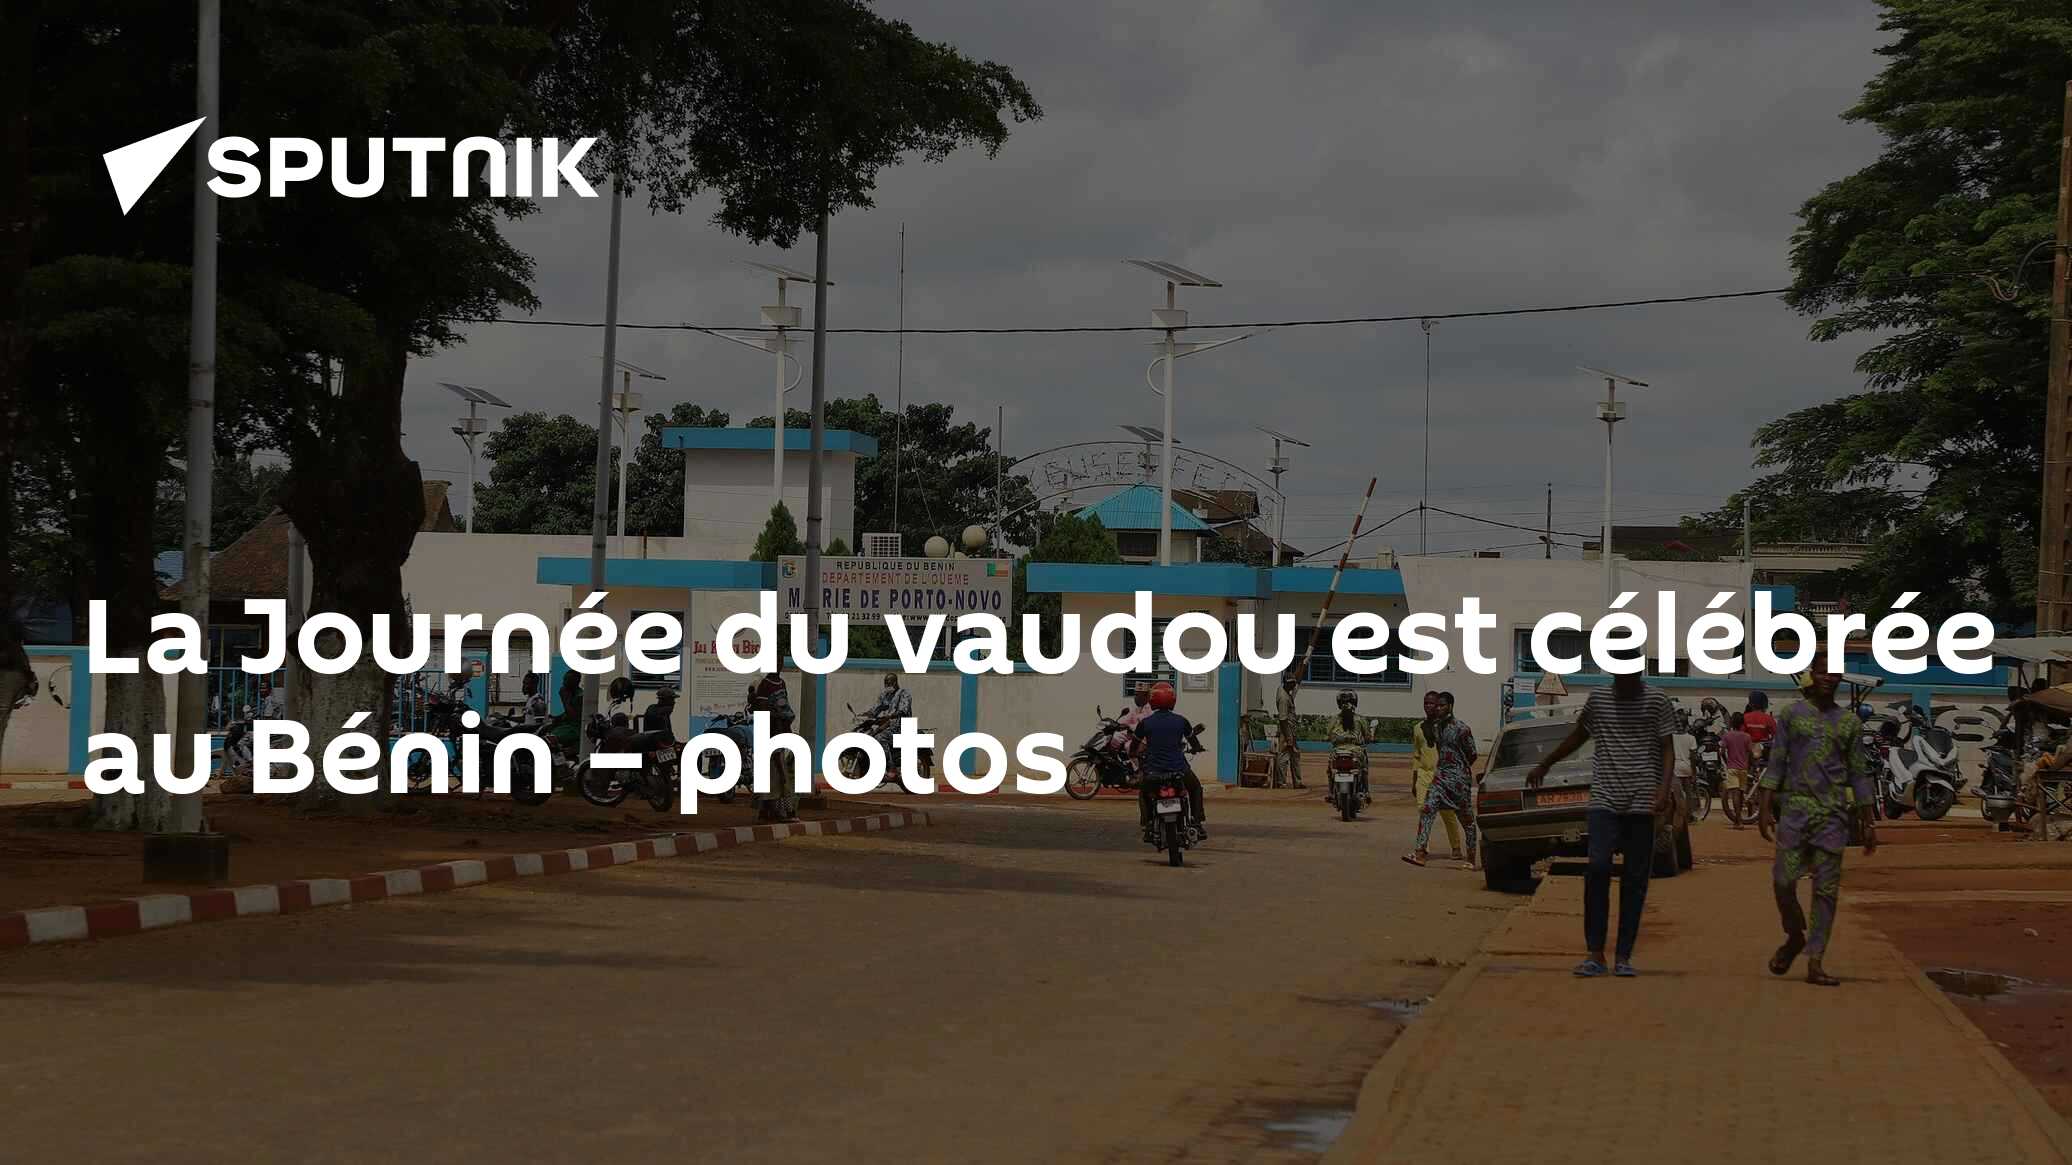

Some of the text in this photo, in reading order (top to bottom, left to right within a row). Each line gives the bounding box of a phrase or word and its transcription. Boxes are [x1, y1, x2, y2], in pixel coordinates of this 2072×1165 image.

[836, 561, 955, 572] REPUBLIQUE DU BENIN
[822, 572, 902, 584] DEPARTEMENT
[904, 573, 918, 585] DE
[788, 587, 1001, 610] MRIE DE PORTO-NOVO
